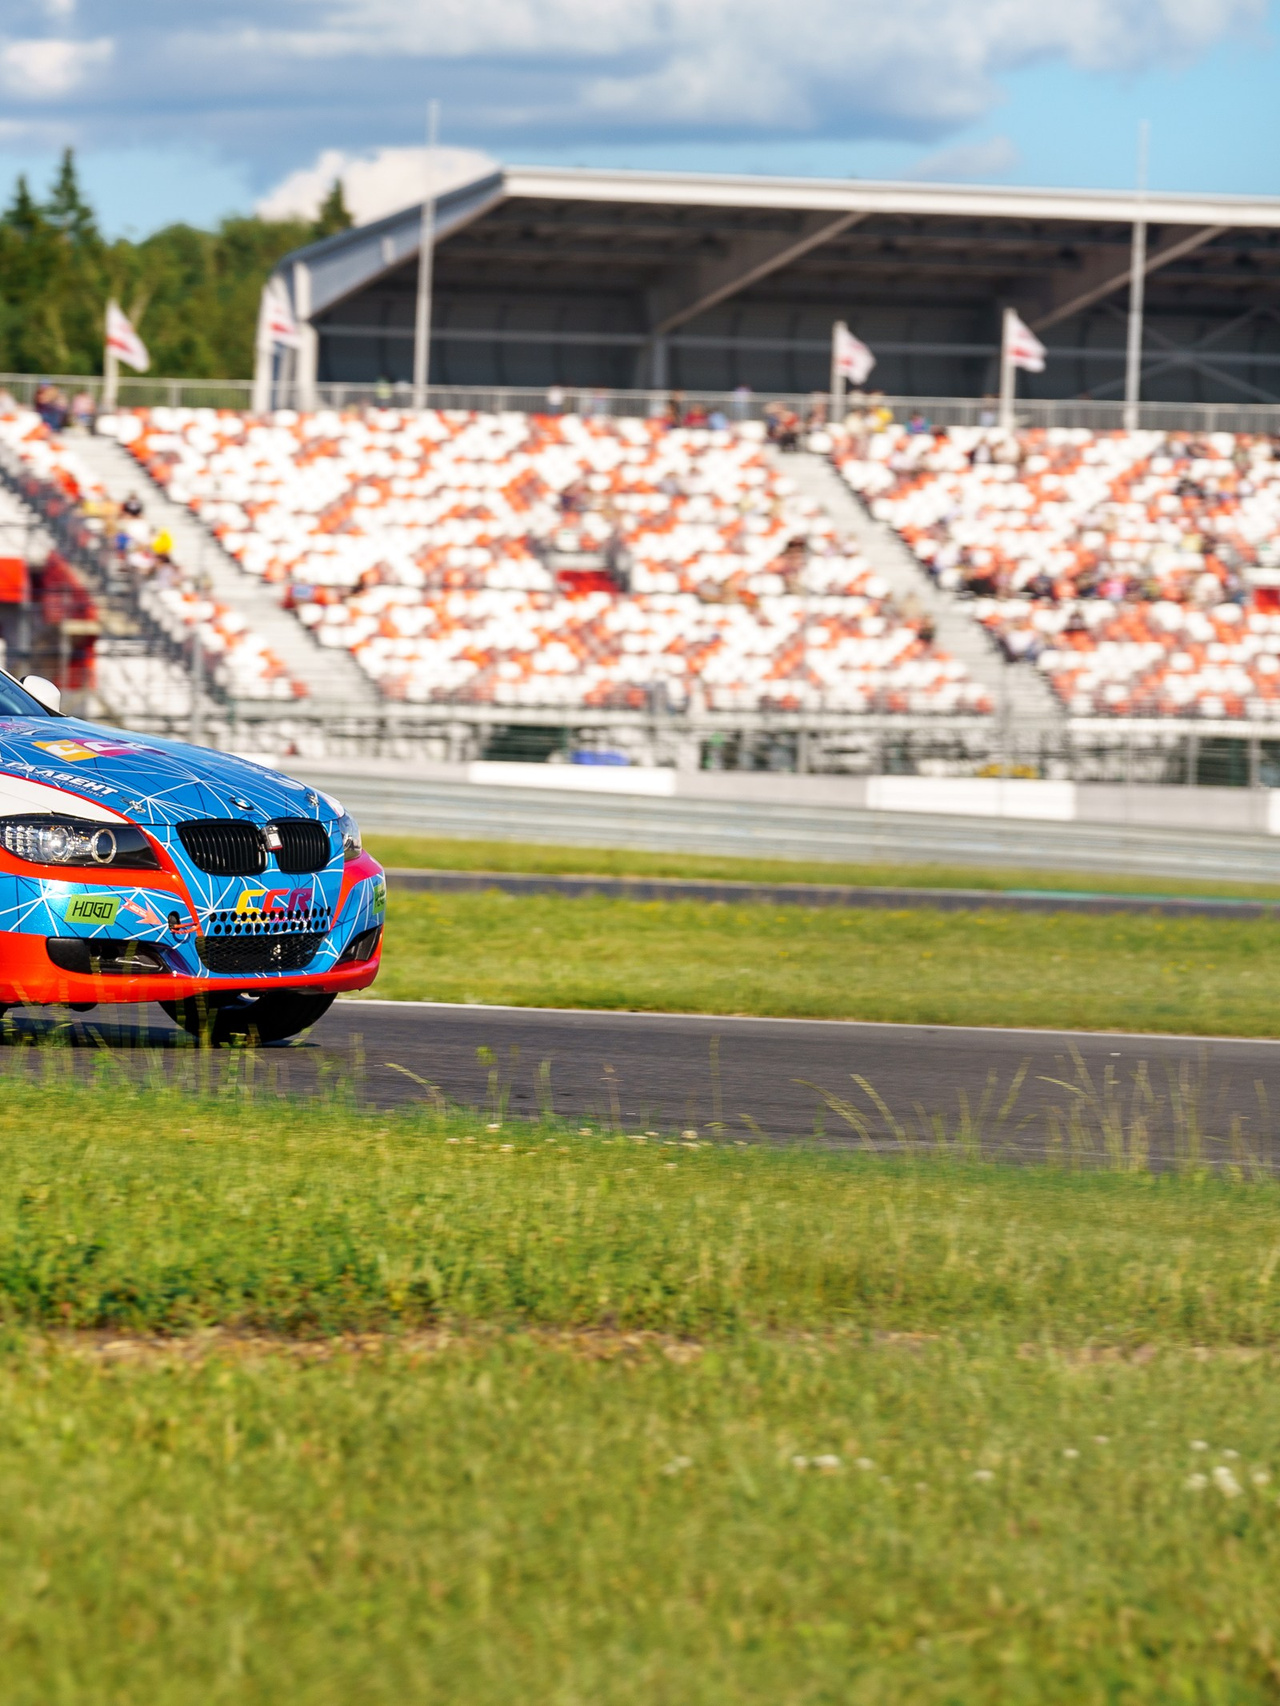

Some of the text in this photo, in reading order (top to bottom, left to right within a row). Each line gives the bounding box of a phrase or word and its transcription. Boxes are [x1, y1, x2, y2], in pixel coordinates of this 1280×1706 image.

[5, 761, 119, 795] ГАЛВЕНТ
[72, 901, 113, 918] HOGO
[235, 888, 313, 915] CCR
